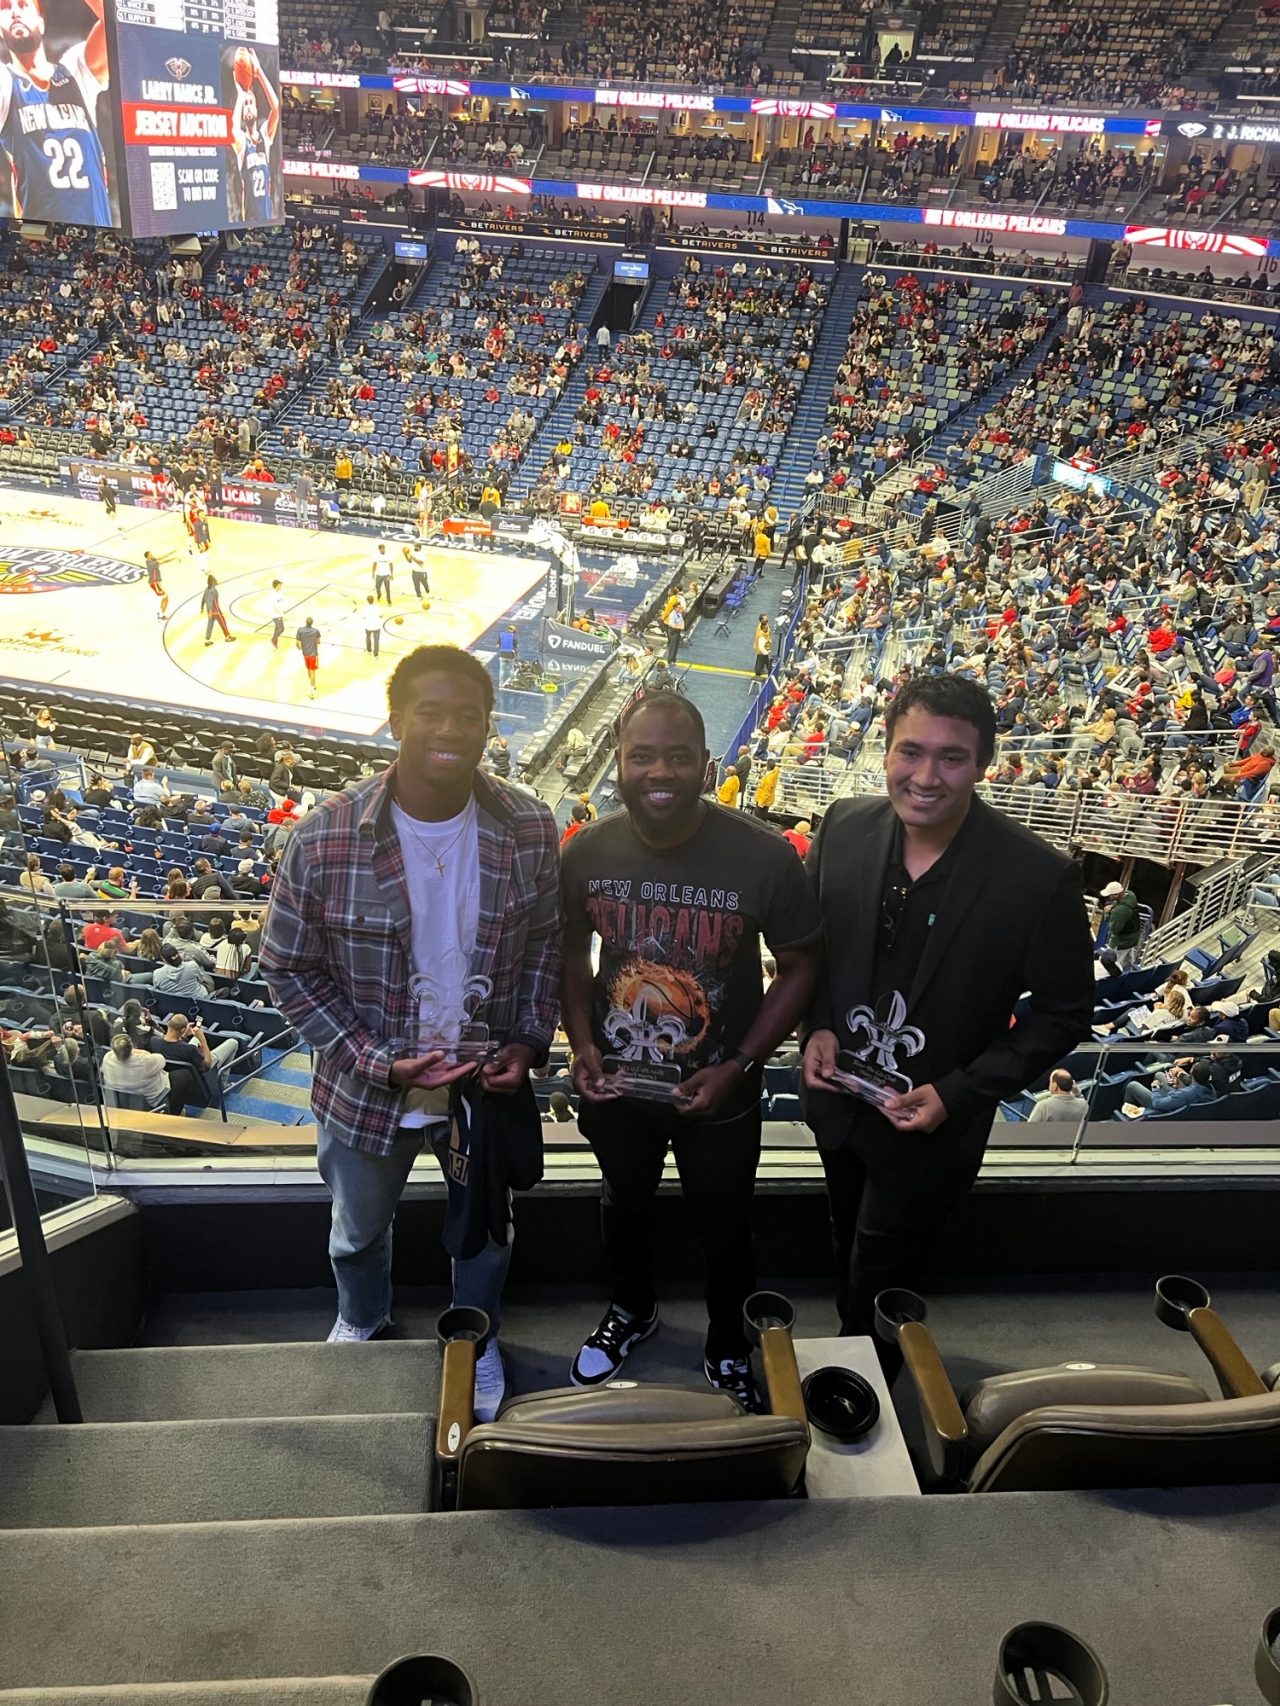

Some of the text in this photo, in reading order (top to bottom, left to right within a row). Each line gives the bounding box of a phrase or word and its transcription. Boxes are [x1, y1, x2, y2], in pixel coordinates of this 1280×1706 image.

[316, 72, 361, 88] PELICANS
[142, 80, 173, 101] LARRY
[174, 82, 203, 104] NANCE
[595, 90, 714, 110] NEW ORLEANS PELICANS
[18, 103, 92, 134] NEW ORLEANS
[135, 110, 227, 138] JERSEY AUCTION
[975, 112, 1105, 133] NEW ORLEANS PELICANS
[1213, 124, 1224, 139] 2
[1227, 125, 1239, 140] J.
[43, 137, 90, 189] 22
[316, 162, 360, 180] PELICANS
[178, 168, 194, 184] SCAN
[204, 168, 219, 183] CODE
[253, 170, 266, 197] 22
[578, 184, 707, 208] NEW ORLEANS PELICANS
[471, 221, 524, 233] BETRIVERS
[747, 211, 765, 226] 114
[925, 209, 1067, 235] NEW ORLEANS PELICANS
[555, 229, 609, 239] BETRIVERS
[682, 239, 737, 250] BETRIVERS
[771, 246, 828, 257] BETRIVERS
[222, 488, 261, 505] LICANS
[33, 549, 148, 584] ORLEANS
[563, 639, 605, 654] FANDUEL
[588, 879, 740, 912] NEW ORLEANS
